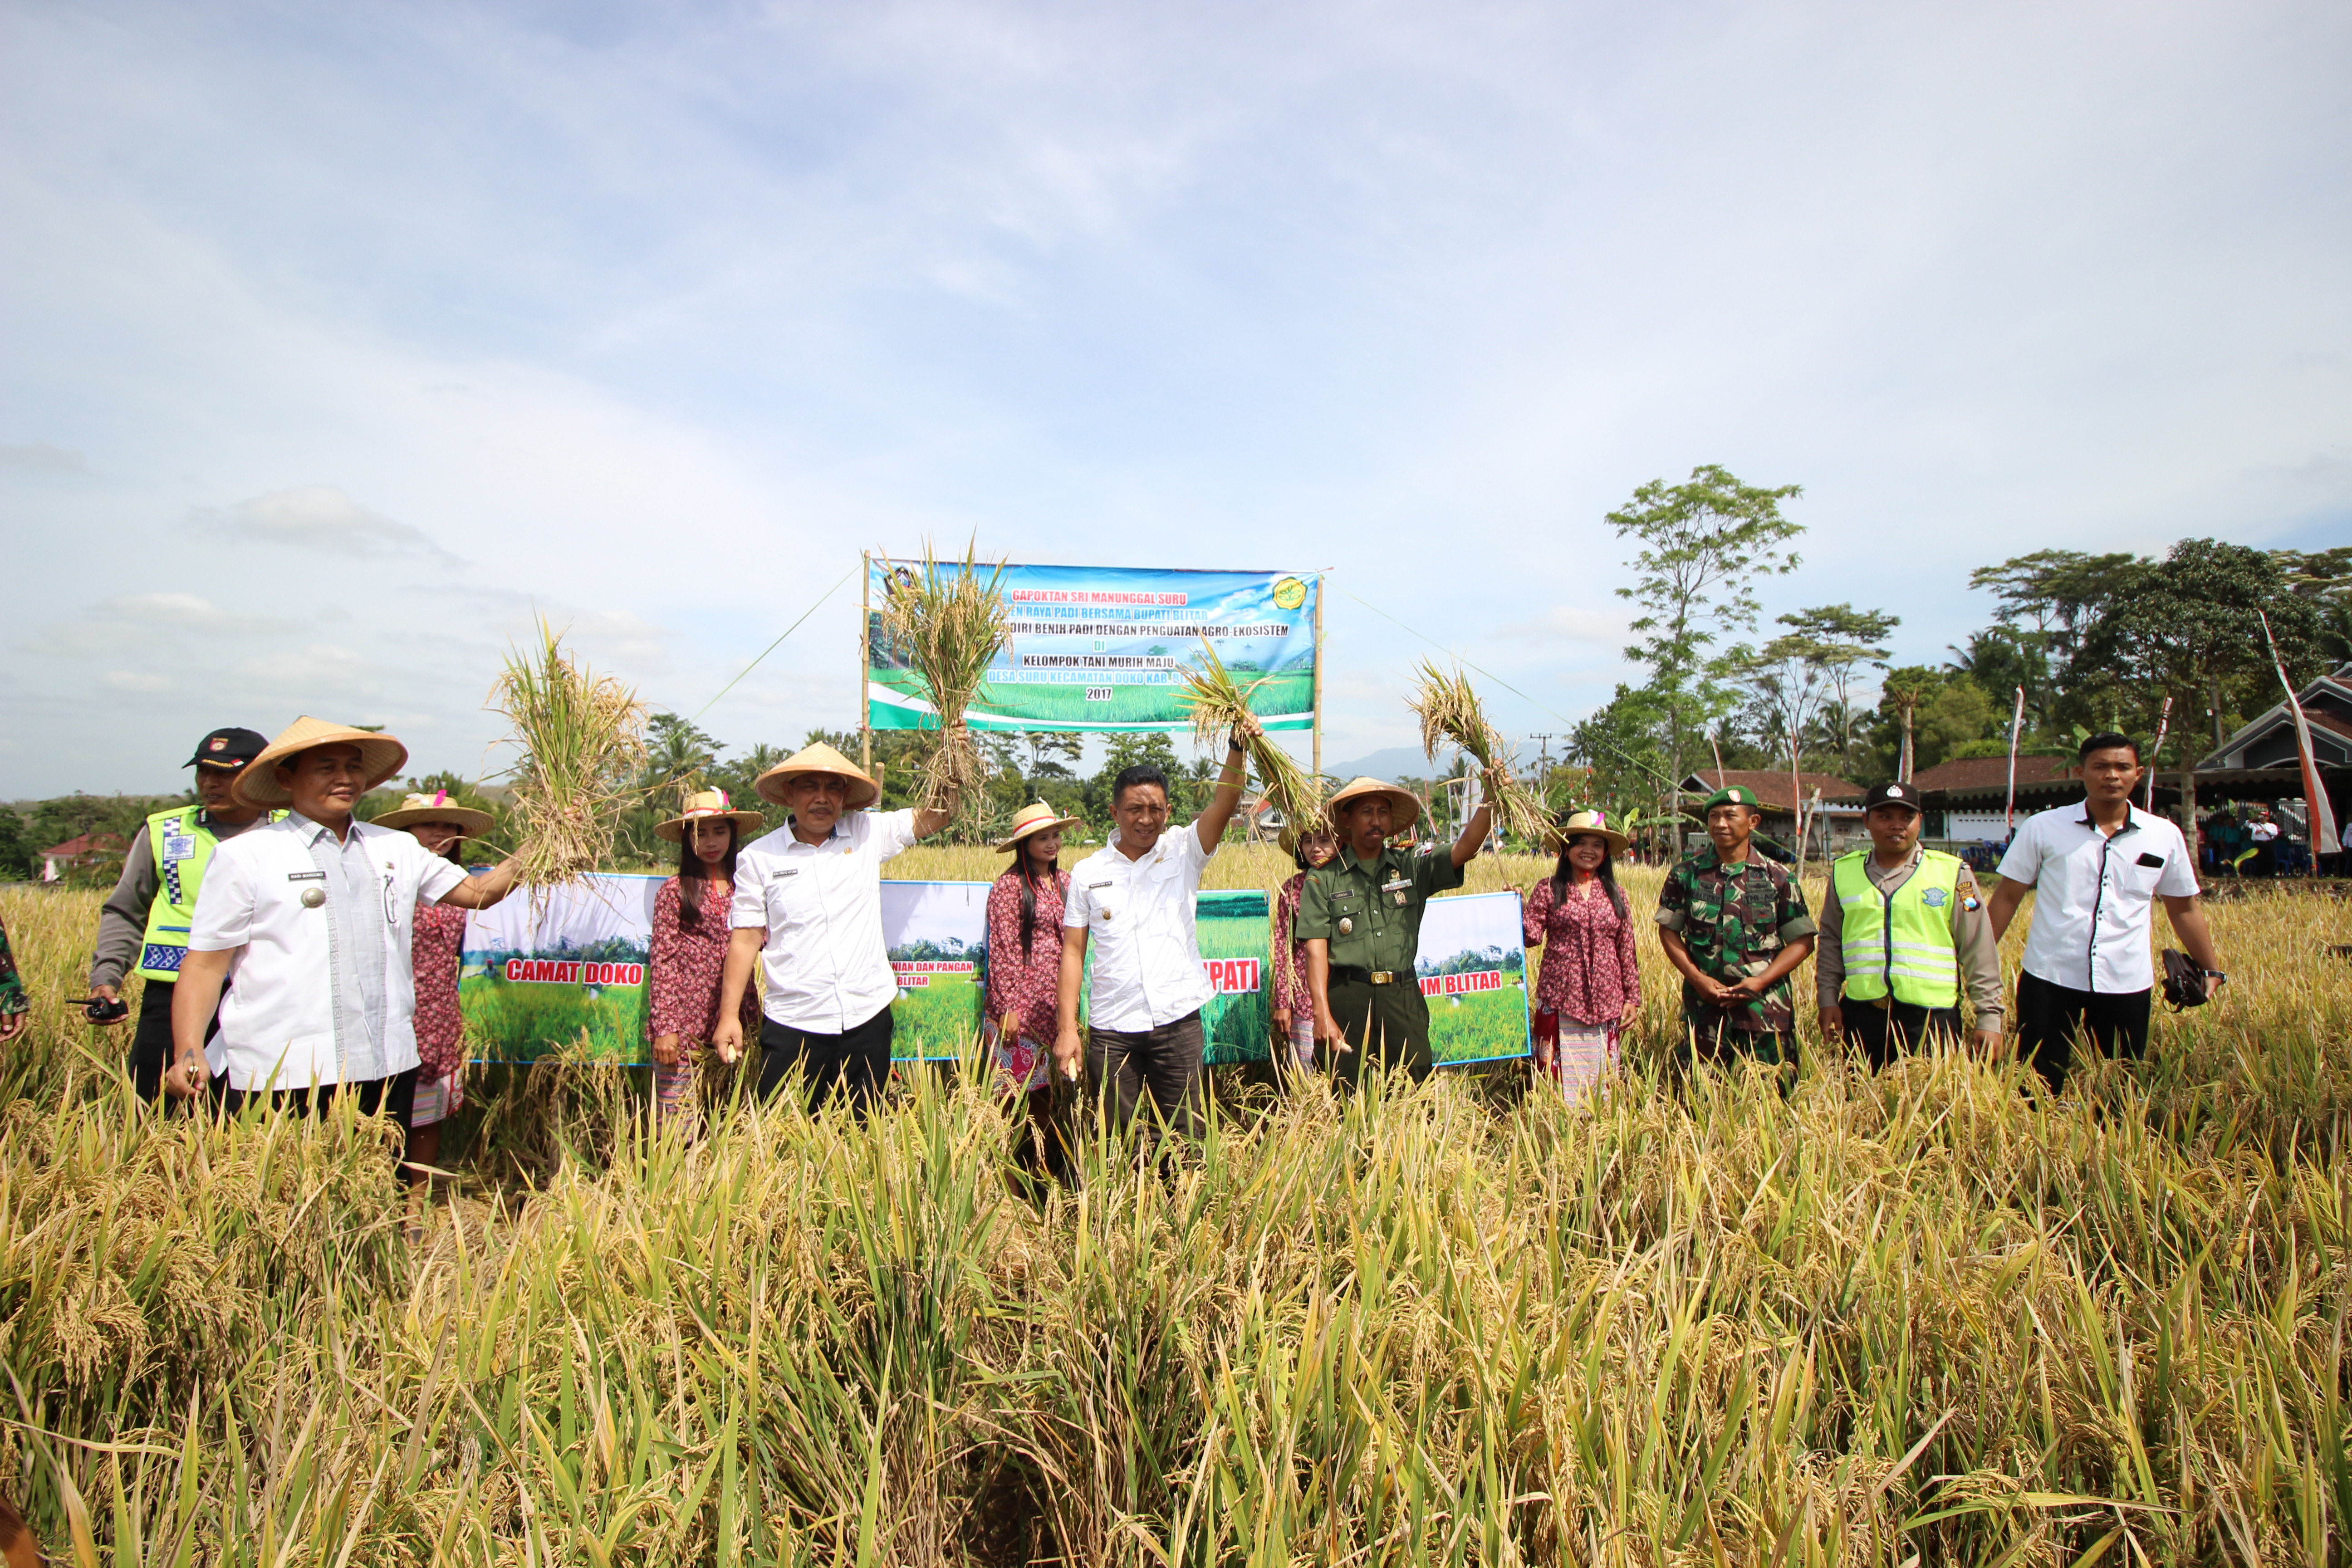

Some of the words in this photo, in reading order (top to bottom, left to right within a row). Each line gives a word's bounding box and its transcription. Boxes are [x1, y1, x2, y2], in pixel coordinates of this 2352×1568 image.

[1013, 590, 1068, 602] GAPOKTAN
[1071, 592, 1088, 602] SRI
[1091, 592, 1155, 604] MANUNGGAL
[1158, 593, 1186, 605] SURU
[1026, 607, 1051, 617] RAYA
[1054, 607, 1078, 618] PADI
[1082, 608, 1131, 619] BERSAMA
[1134, 609, 1170, 620] BUPATI
[1173, 610, 1208, 620] BLITAR
[1035, 623, 1066, 634] BENIH
[1069, 624, 1093, 635] PADI
[1096, 625, 1137, 636] DENGAN
[1140, 626, 1198, 636] PENGUATAN
[1094, 641, 1105, 651] DI
[1024, 656, 1079, 666] KELOMPOK
[1082, 656, 1105, 666] TANI
[1108, 657, 1143, 667] MURIH
[1146, 657, 1174, 667] MAJU
[989, 671, 1016, 681] DESA
[1019, 671, 1047, 682] SURU
[1050, 672, 1112, 683] KECAMATAN
[1115, 673, 1143, 683] DOKO
[1147, 673, 1171, 683] KAB.
[1087, 689, 1111, 699] 2017
[507, 960, 581, 982] CAMAT
[584, 963, 642, 985] DOKO
[916, 963, 934, 971] DAN
[936, 962, 972, 971] PANGAN
[897, 976, 928, 985] BLITAR
[1203, 960, 1258, 990] PATI
[1445, 971, 1500, 993] BLITAR
